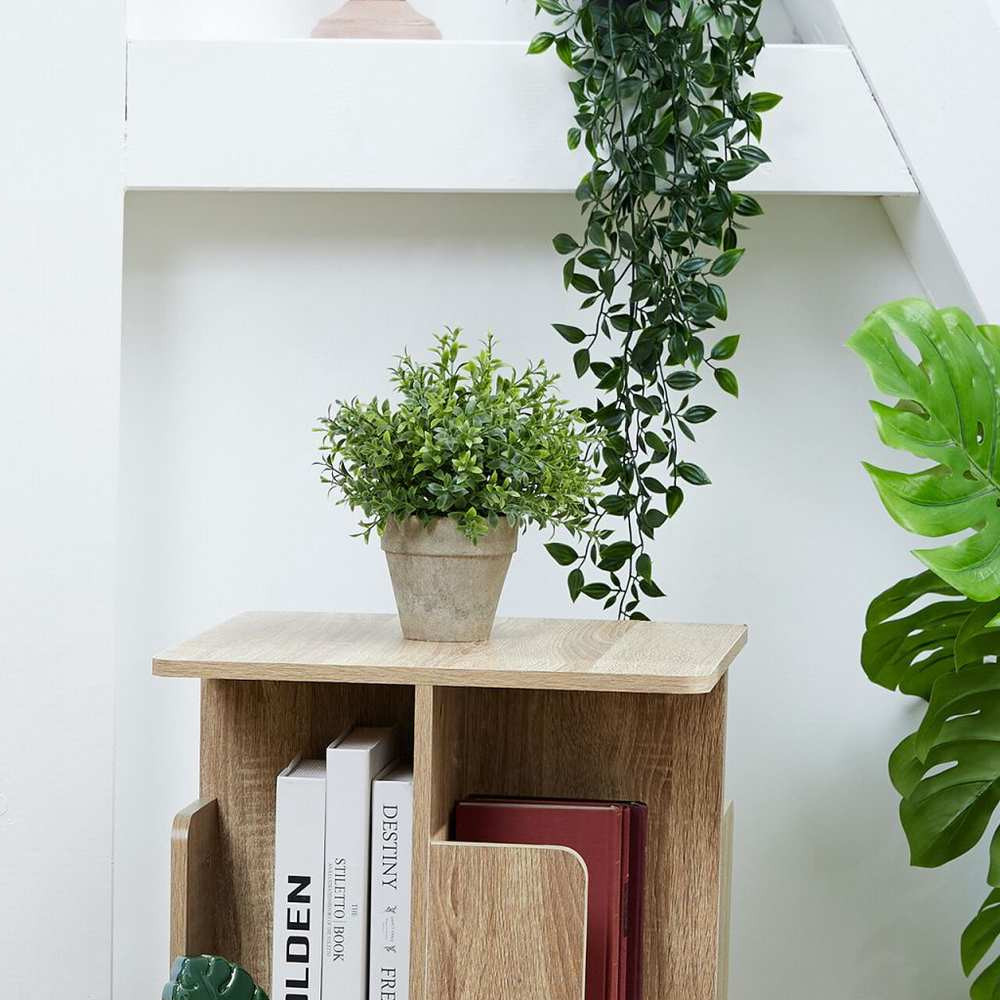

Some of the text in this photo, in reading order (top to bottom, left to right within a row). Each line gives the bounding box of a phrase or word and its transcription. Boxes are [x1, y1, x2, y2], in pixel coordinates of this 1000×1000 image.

[382, 805, 398, 890] DESTINY
[333, 857, 346, 962] STILETTO BOOK
